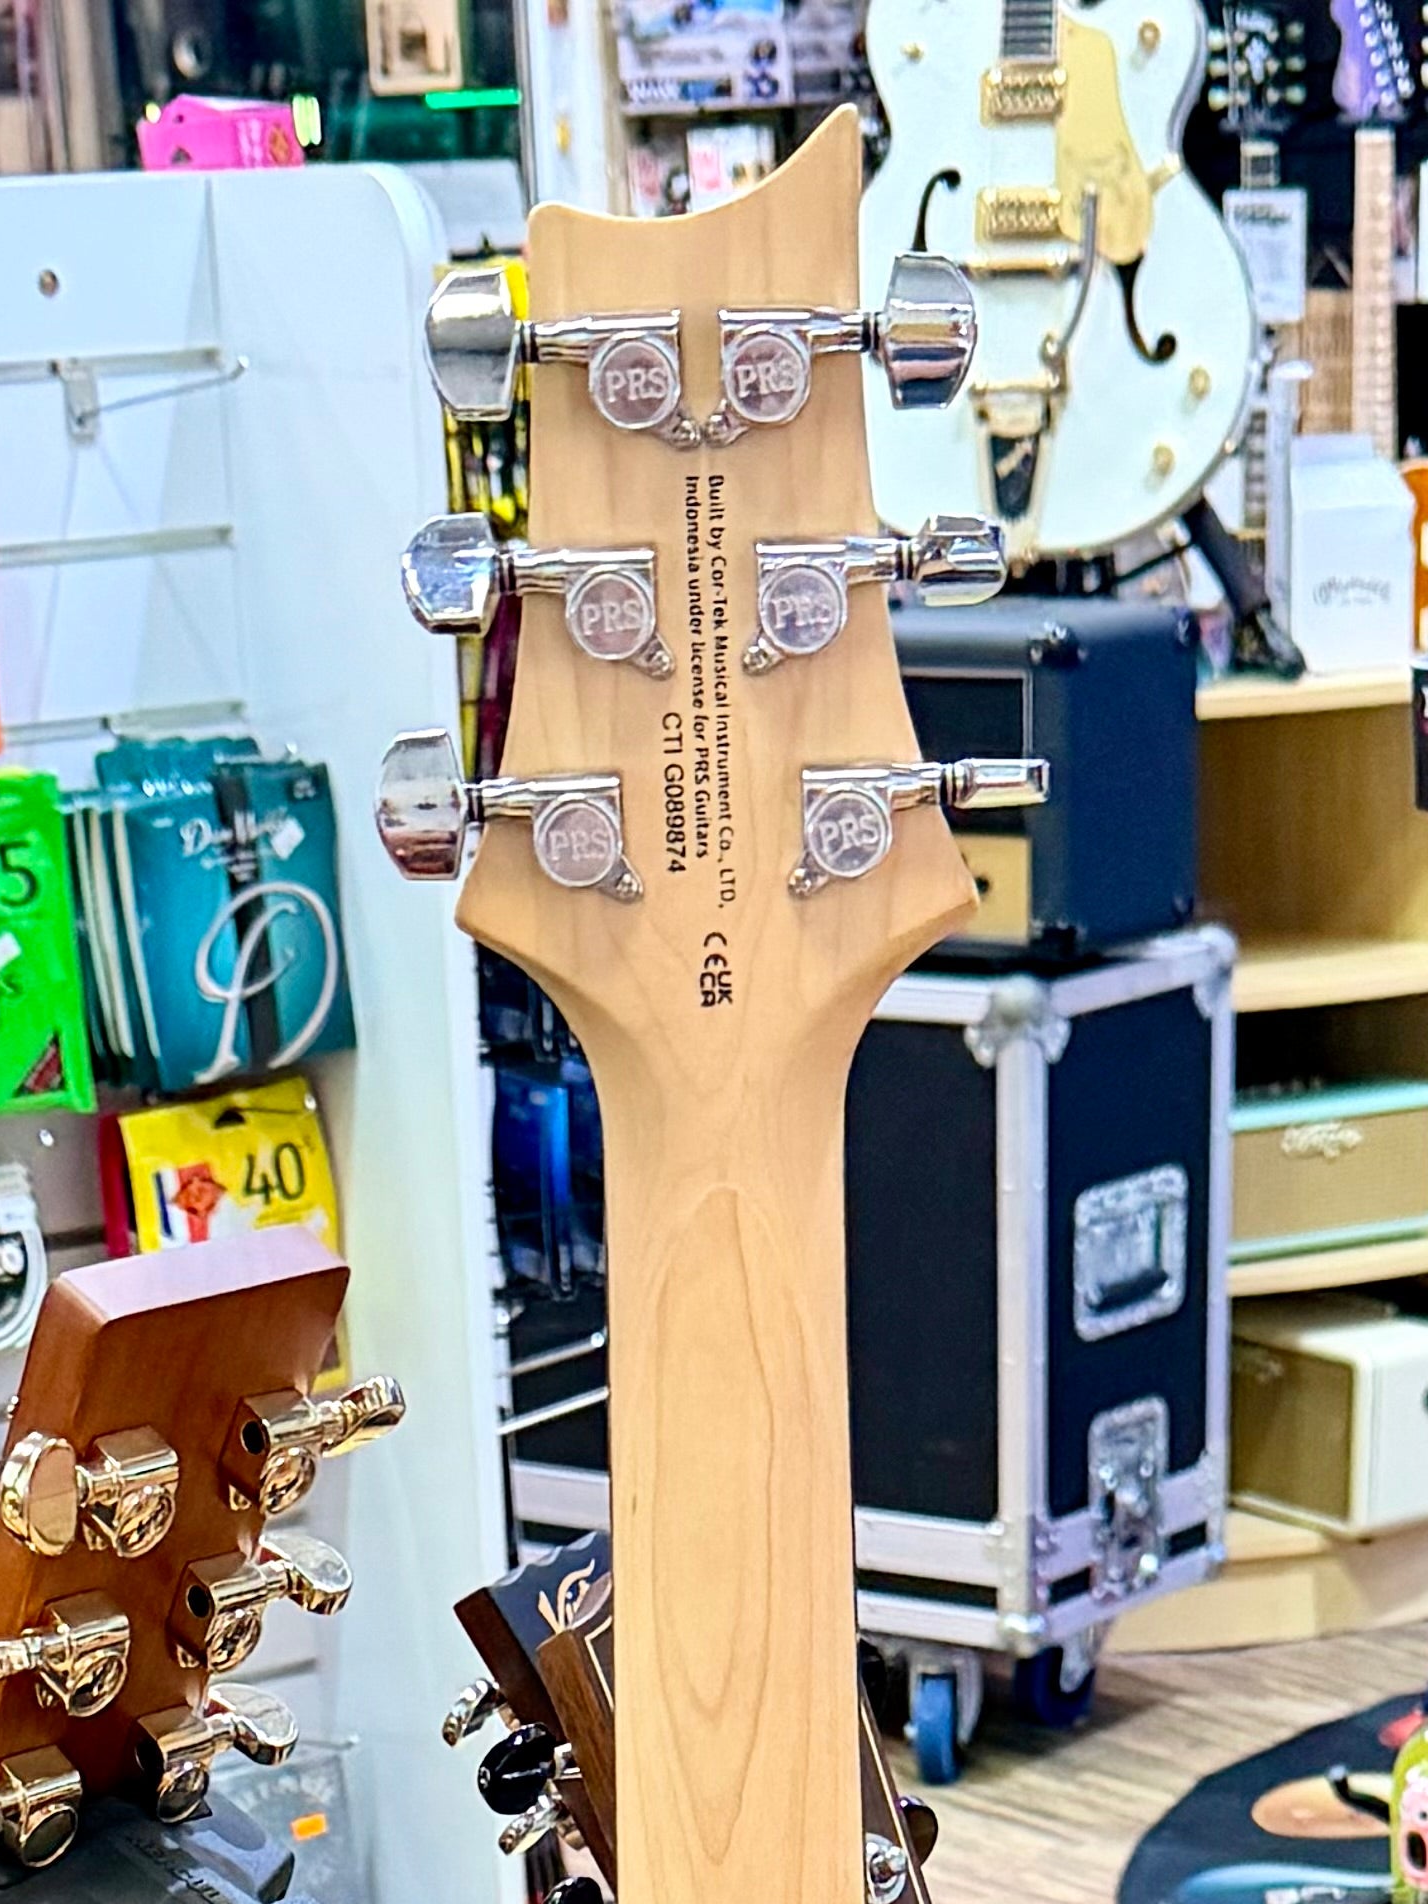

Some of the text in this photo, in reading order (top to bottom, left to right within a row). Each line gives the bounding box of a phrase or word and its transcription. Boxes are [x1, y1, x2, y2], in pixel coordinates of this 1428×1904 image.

[606, 366, 669, 402] PRS
[735, 359, 796, 398] PRS
[708, 475, 725, 520] Built
[706, 526, 725, 549] by
[711, 555, 729, 630] Cor-Tek
[772, 594, 833, 630] PRS
[580, 599, 645, 634] PRS
[685, 475, 711, 859] Indonesia under license for PRS Guitars
[714, 636, 731, 708] Musical
[715, 714, 732, 820] Instrument
[662, 711, 687, 873] CTI G089874
[549, 829, 610, 863] PRS
[820, 814, 881, 855] PRS
[243, 1142, 306, 1206] 40
